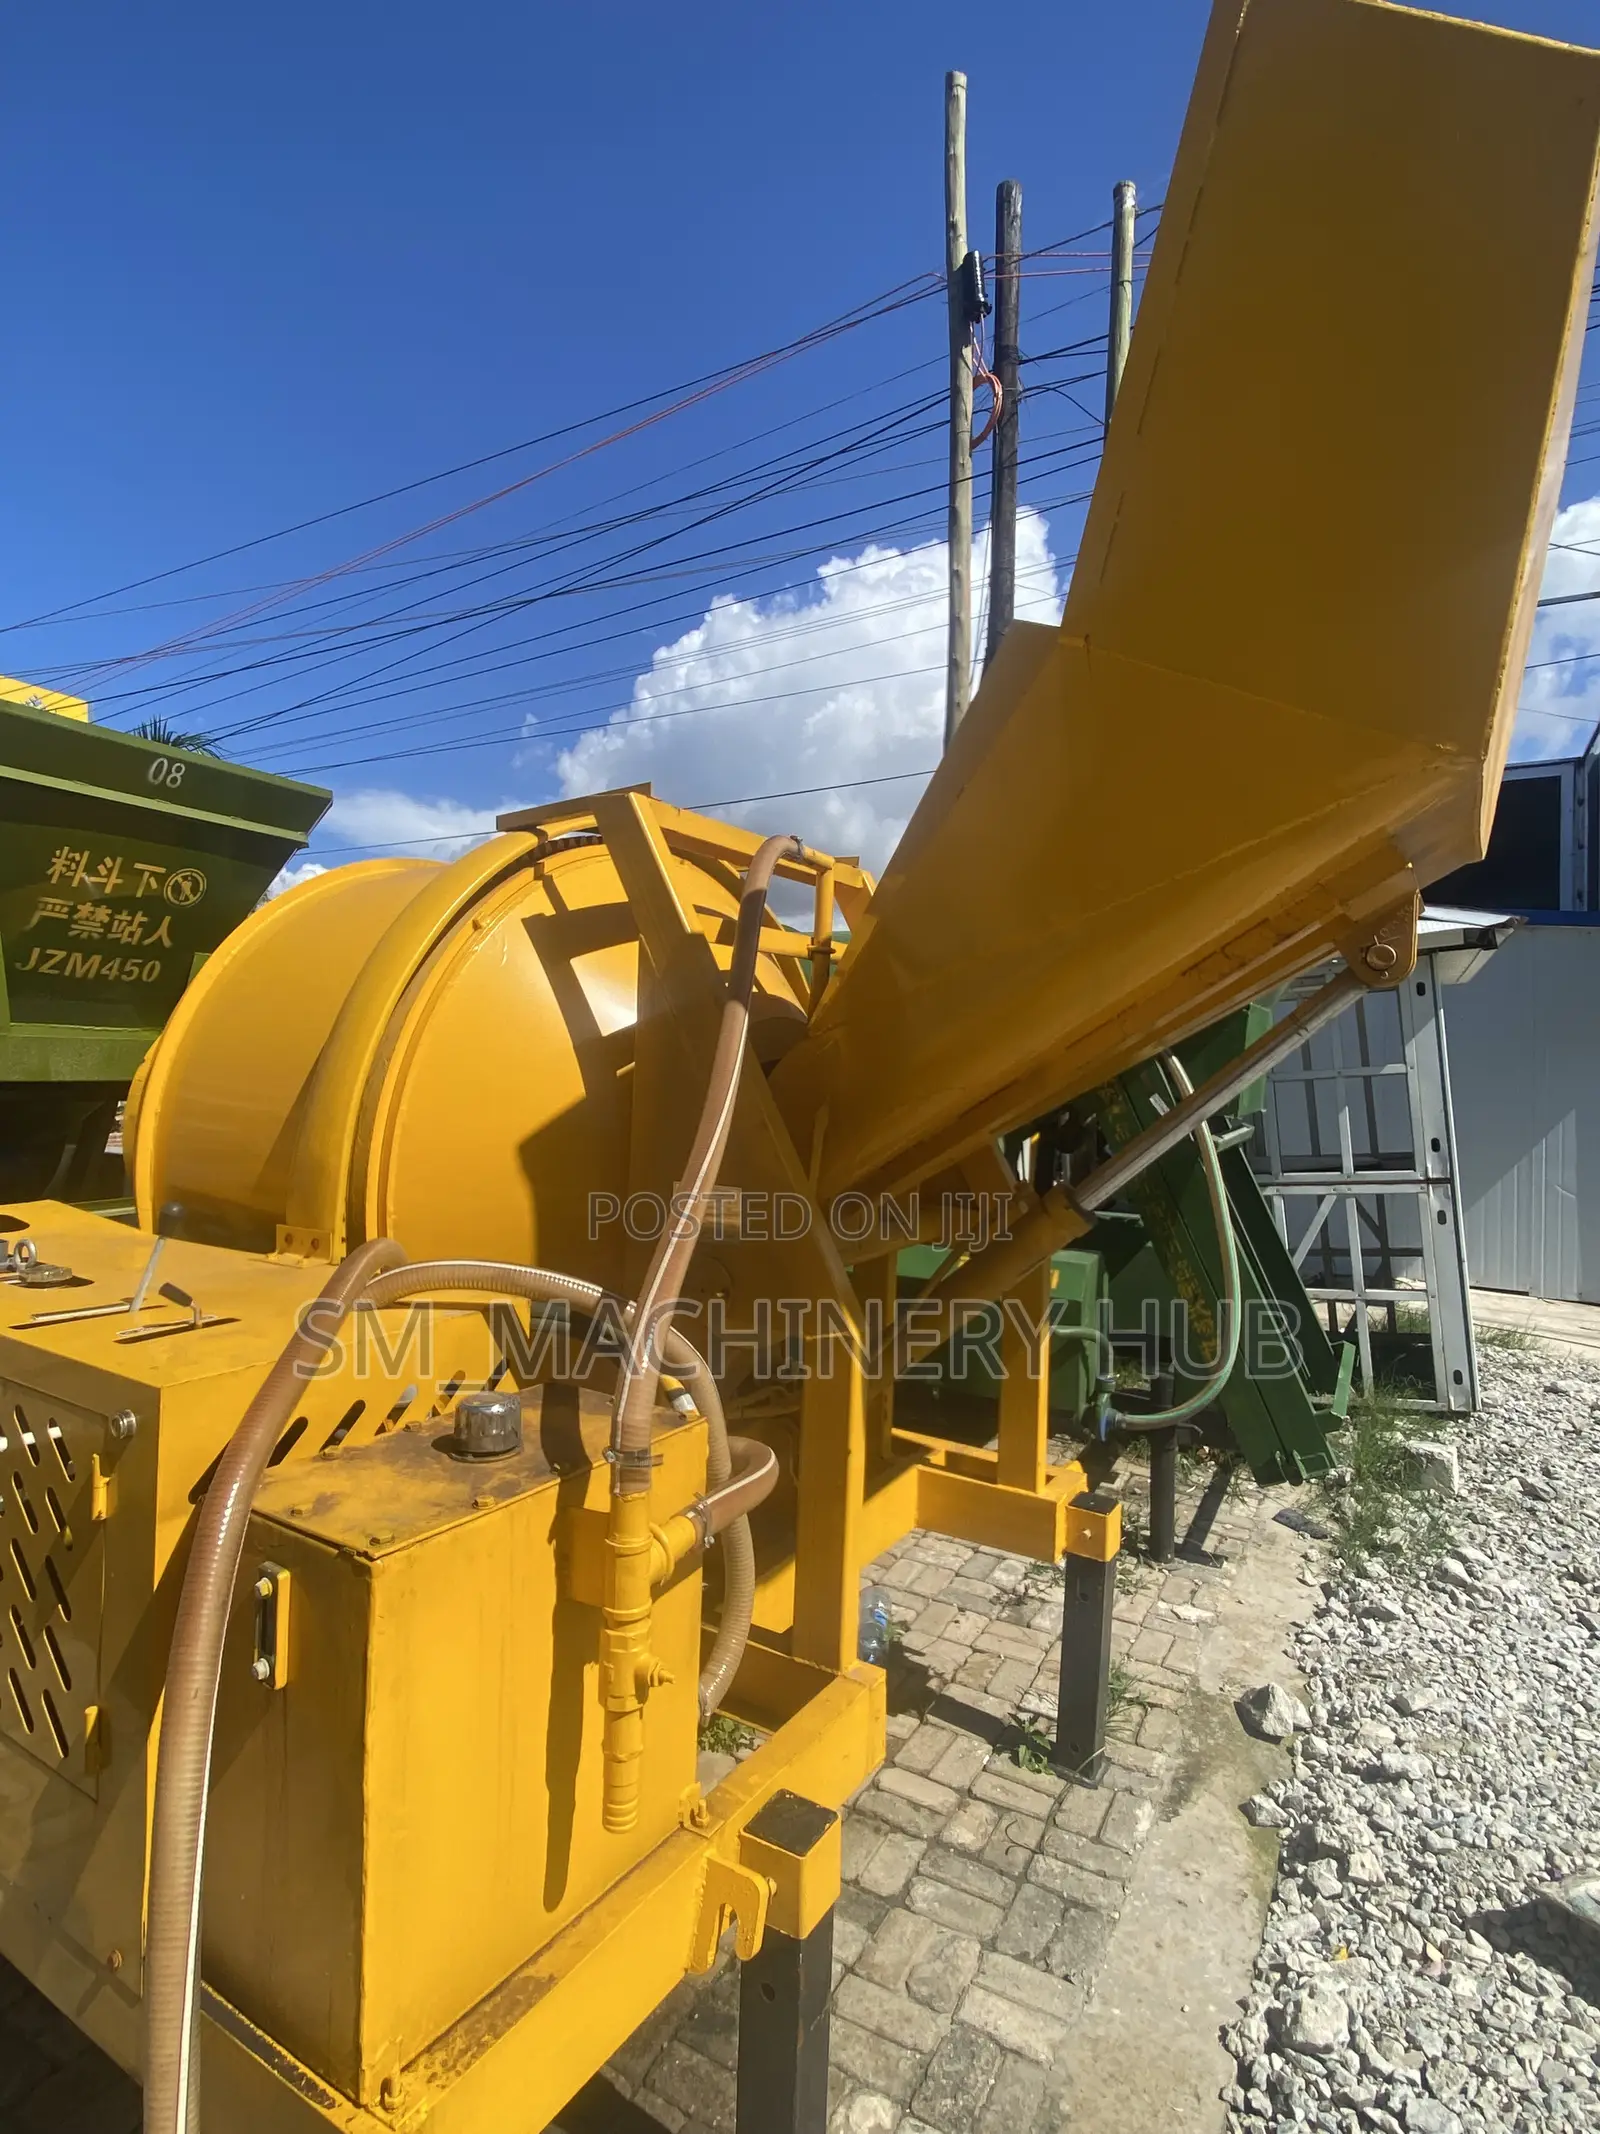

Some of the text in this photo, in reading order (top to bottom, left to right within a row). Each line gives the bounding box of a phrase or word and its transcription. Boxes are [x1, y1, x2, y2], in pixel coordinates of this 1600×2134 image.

[148, 757, 185, 788] 08
[46, 846, 167, 897] 料斗下
[22, 896, 173, 949] 严禁站人
[15, 946, 162, 982] JZM450
